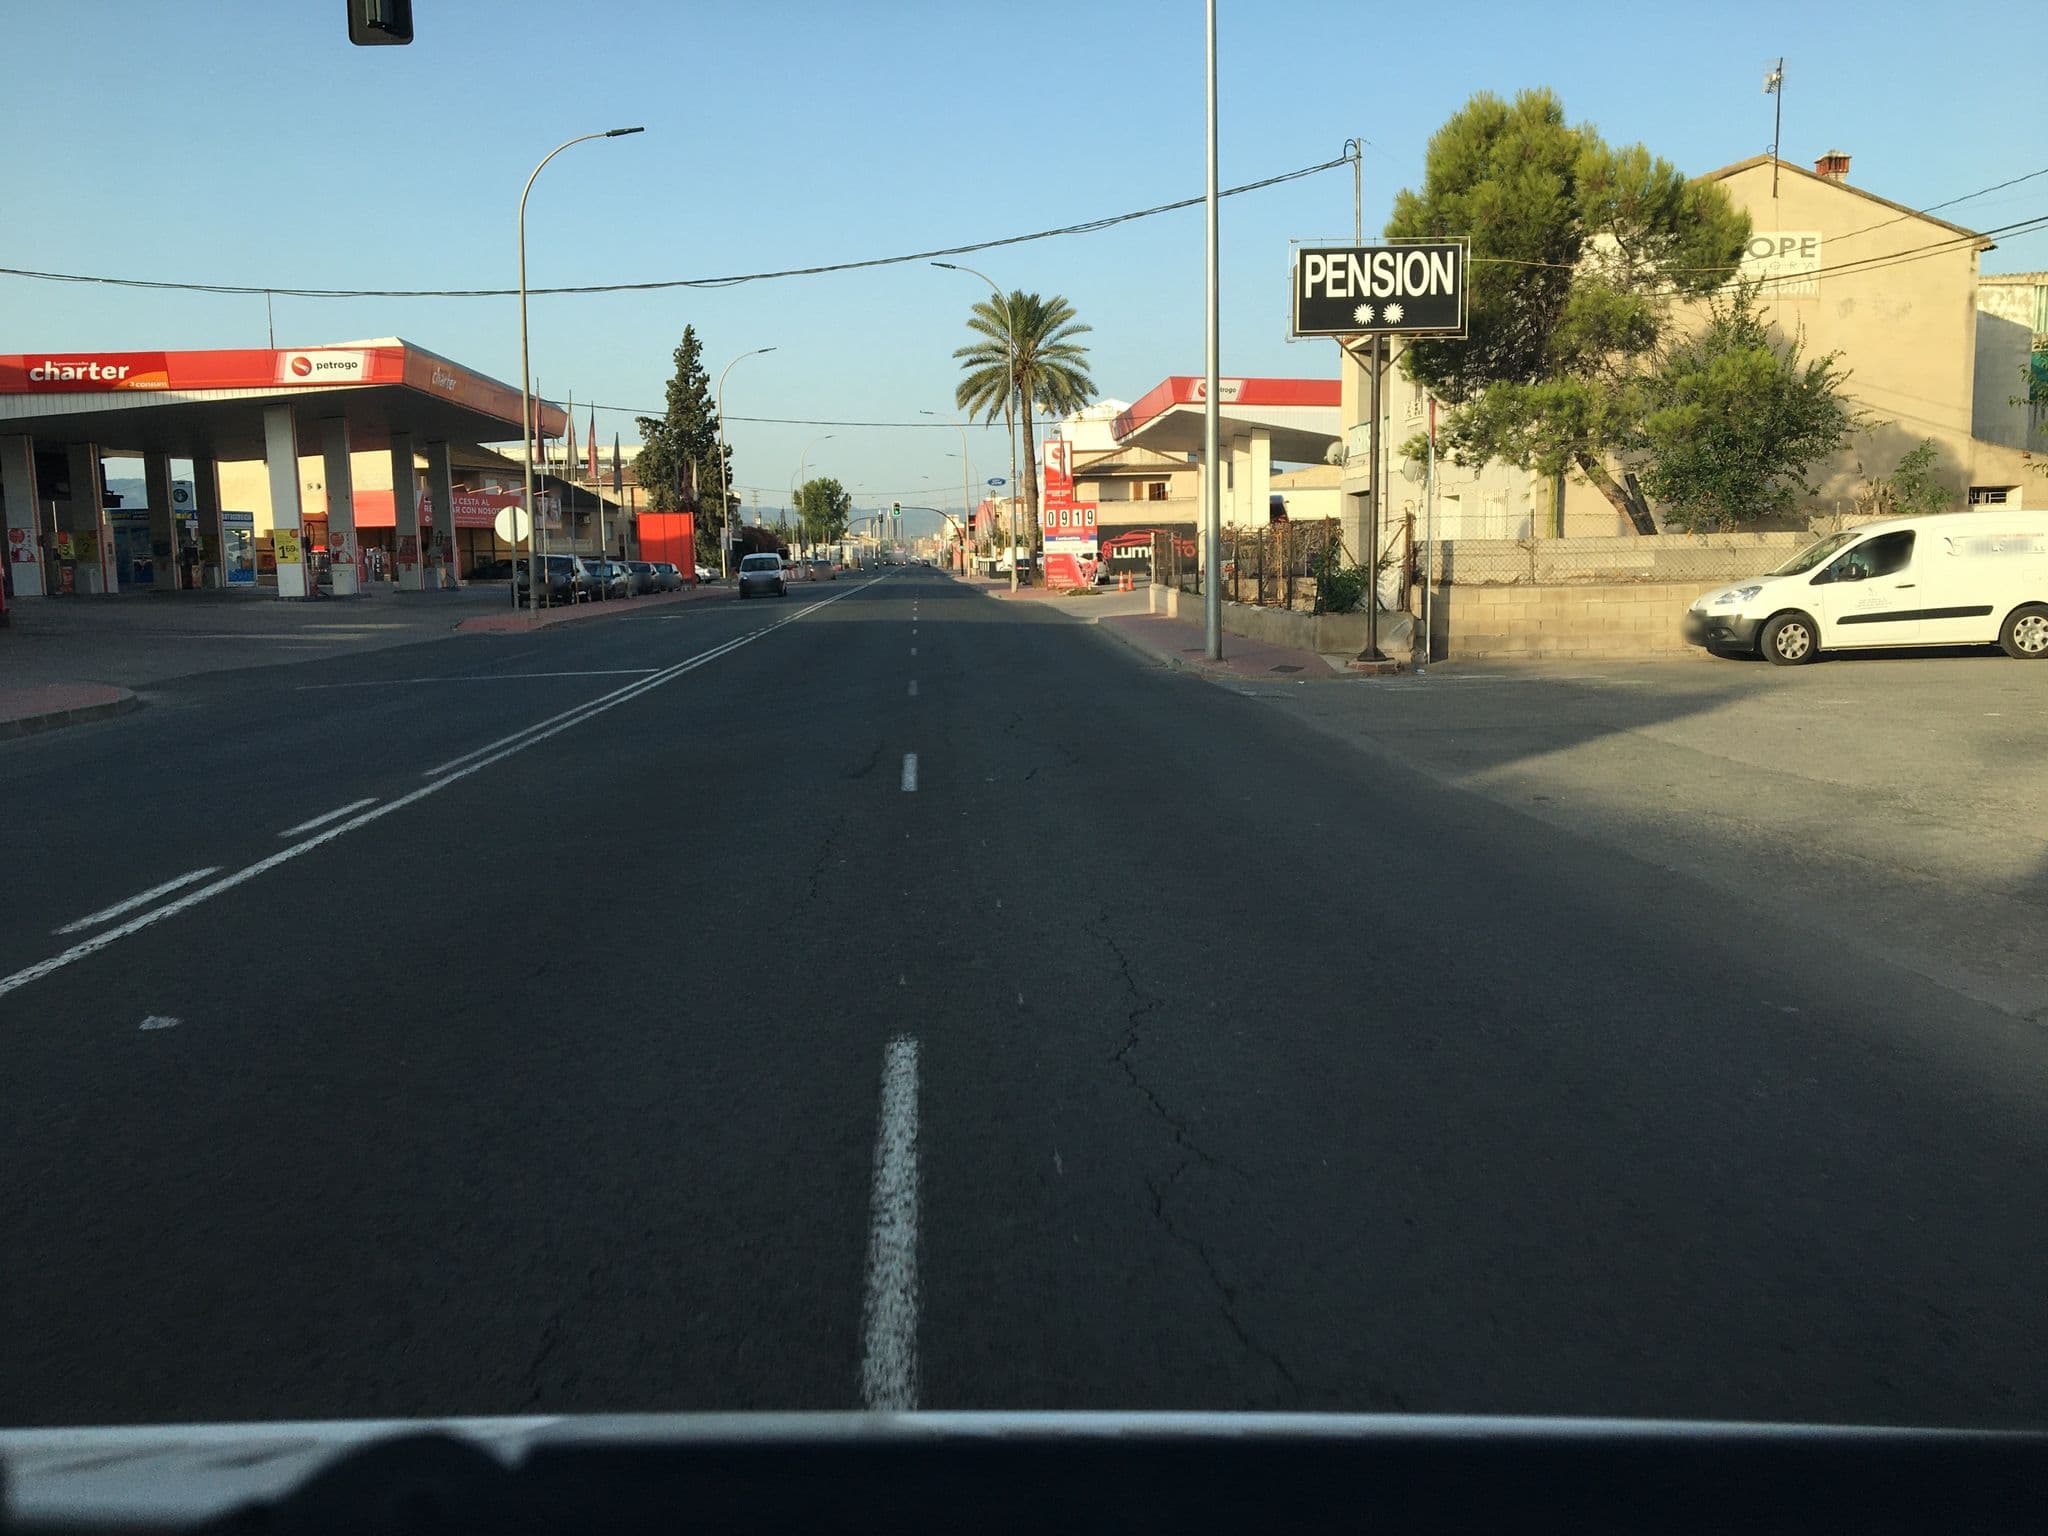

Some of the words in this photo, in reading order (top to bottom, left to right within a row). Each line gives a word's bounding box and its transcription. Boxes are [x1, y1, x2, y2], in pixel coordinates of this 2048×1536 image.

[1305, 251, 1454, 298] PENSION
[29, 361, 130, 382] charter
[316, 359, 358, 370] petrogo
[431, 366, 457, 391] charter
[462, 506, 477, 514] CON
